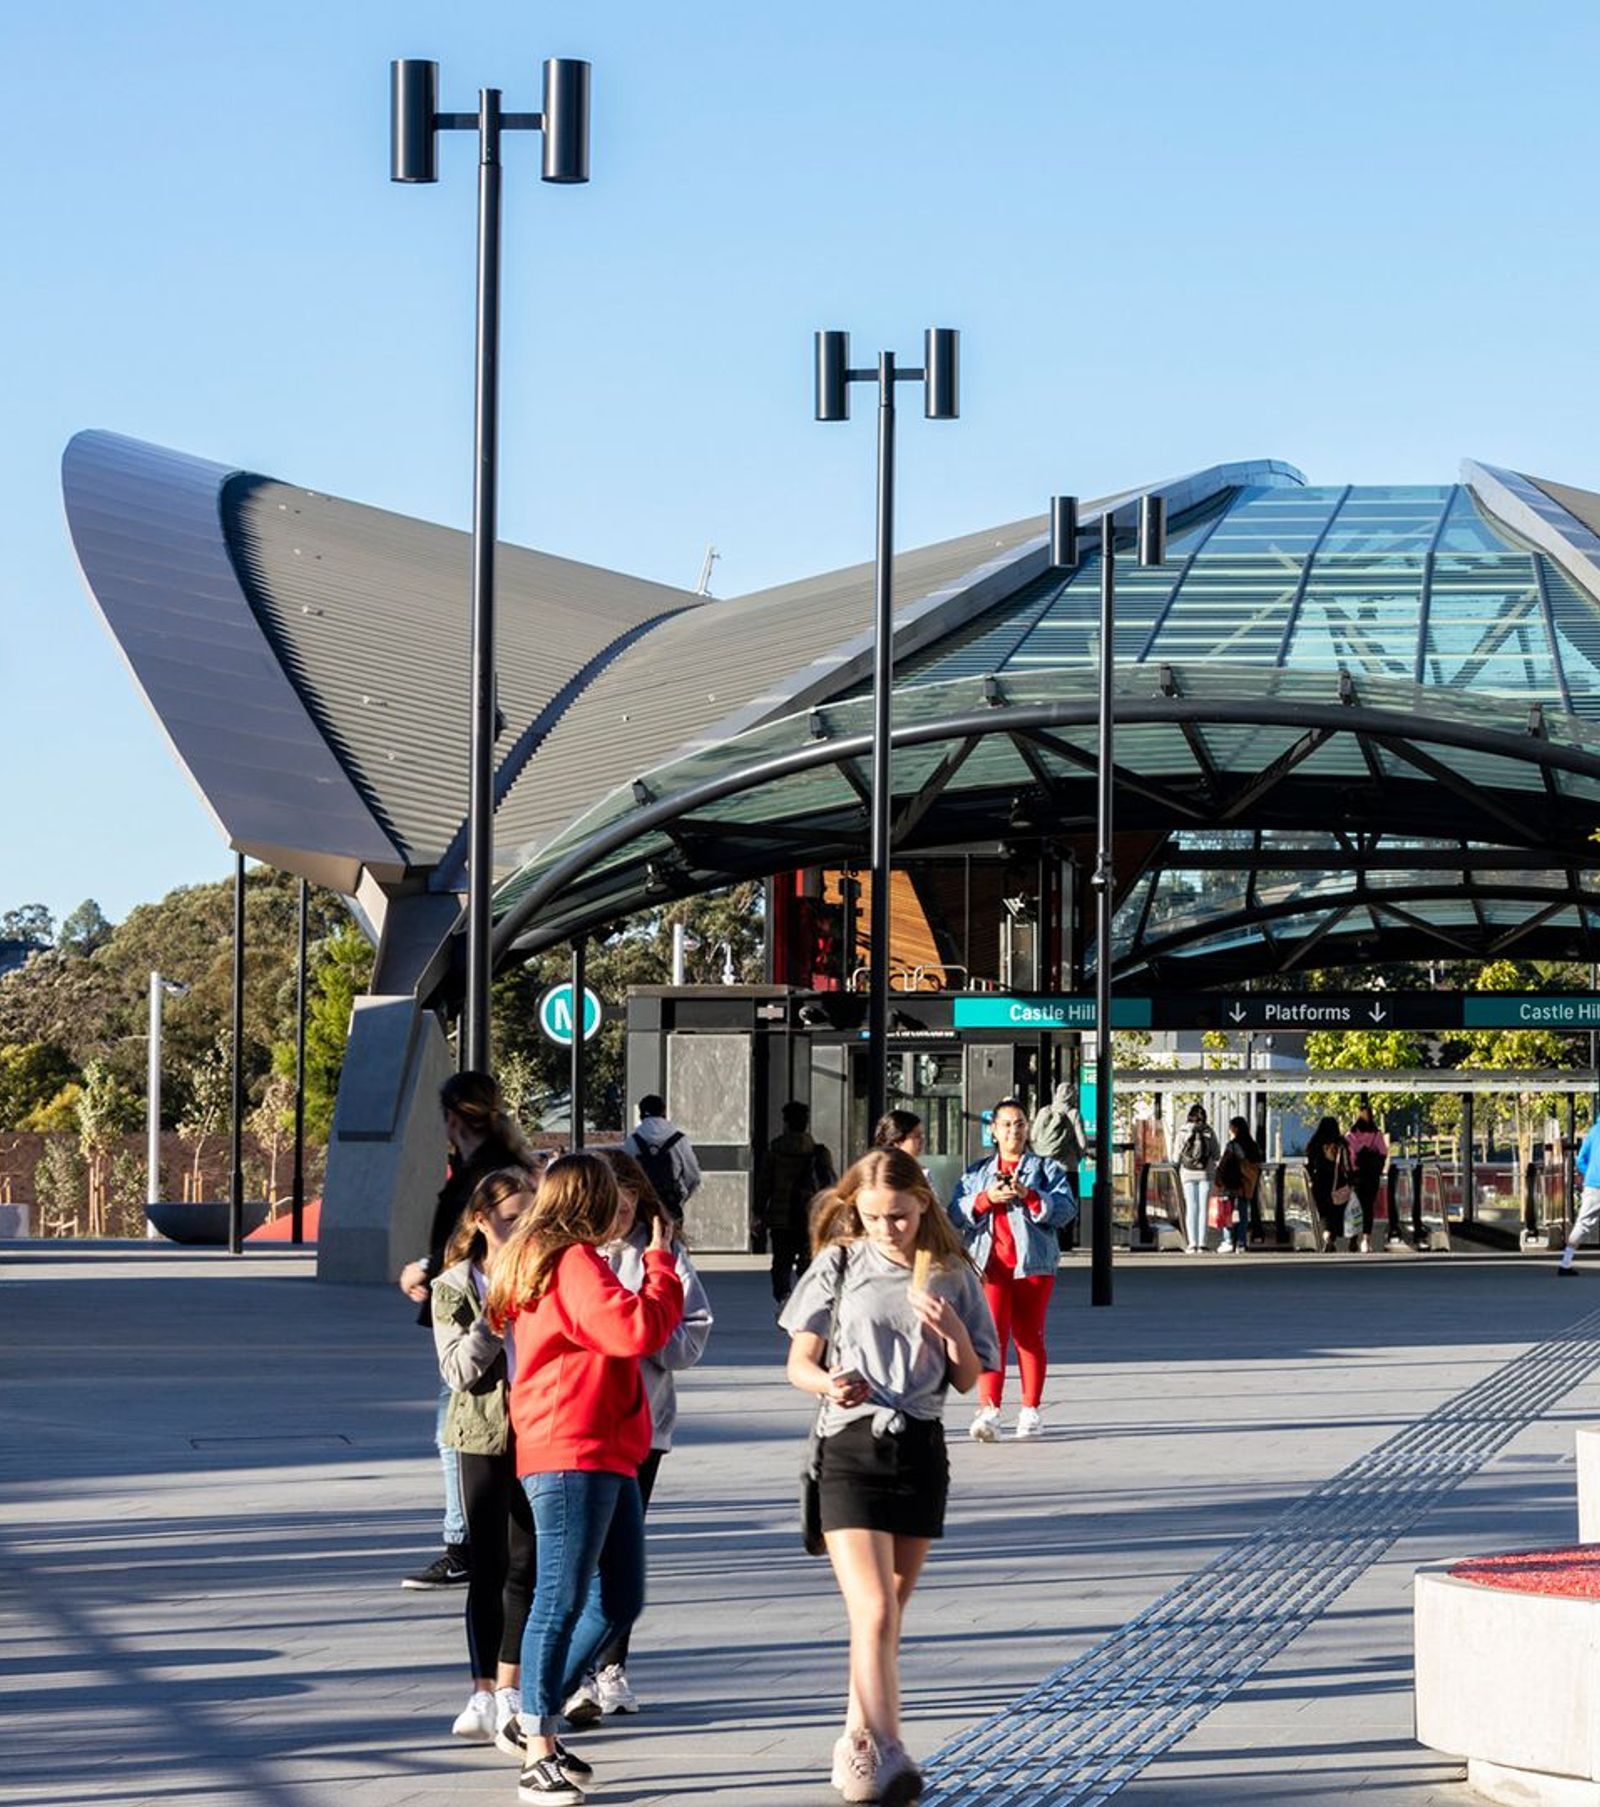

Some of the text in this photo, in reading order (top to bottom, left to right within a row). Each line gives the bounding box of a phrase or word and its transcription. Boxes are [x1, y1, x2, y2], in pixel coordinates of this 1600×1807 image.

[1009, 1003, 1096, 1021] Castle Hill
[1264, 1003, 1351, 1021] Platforms
[1519, 1003, 1575, 1020] Castle
